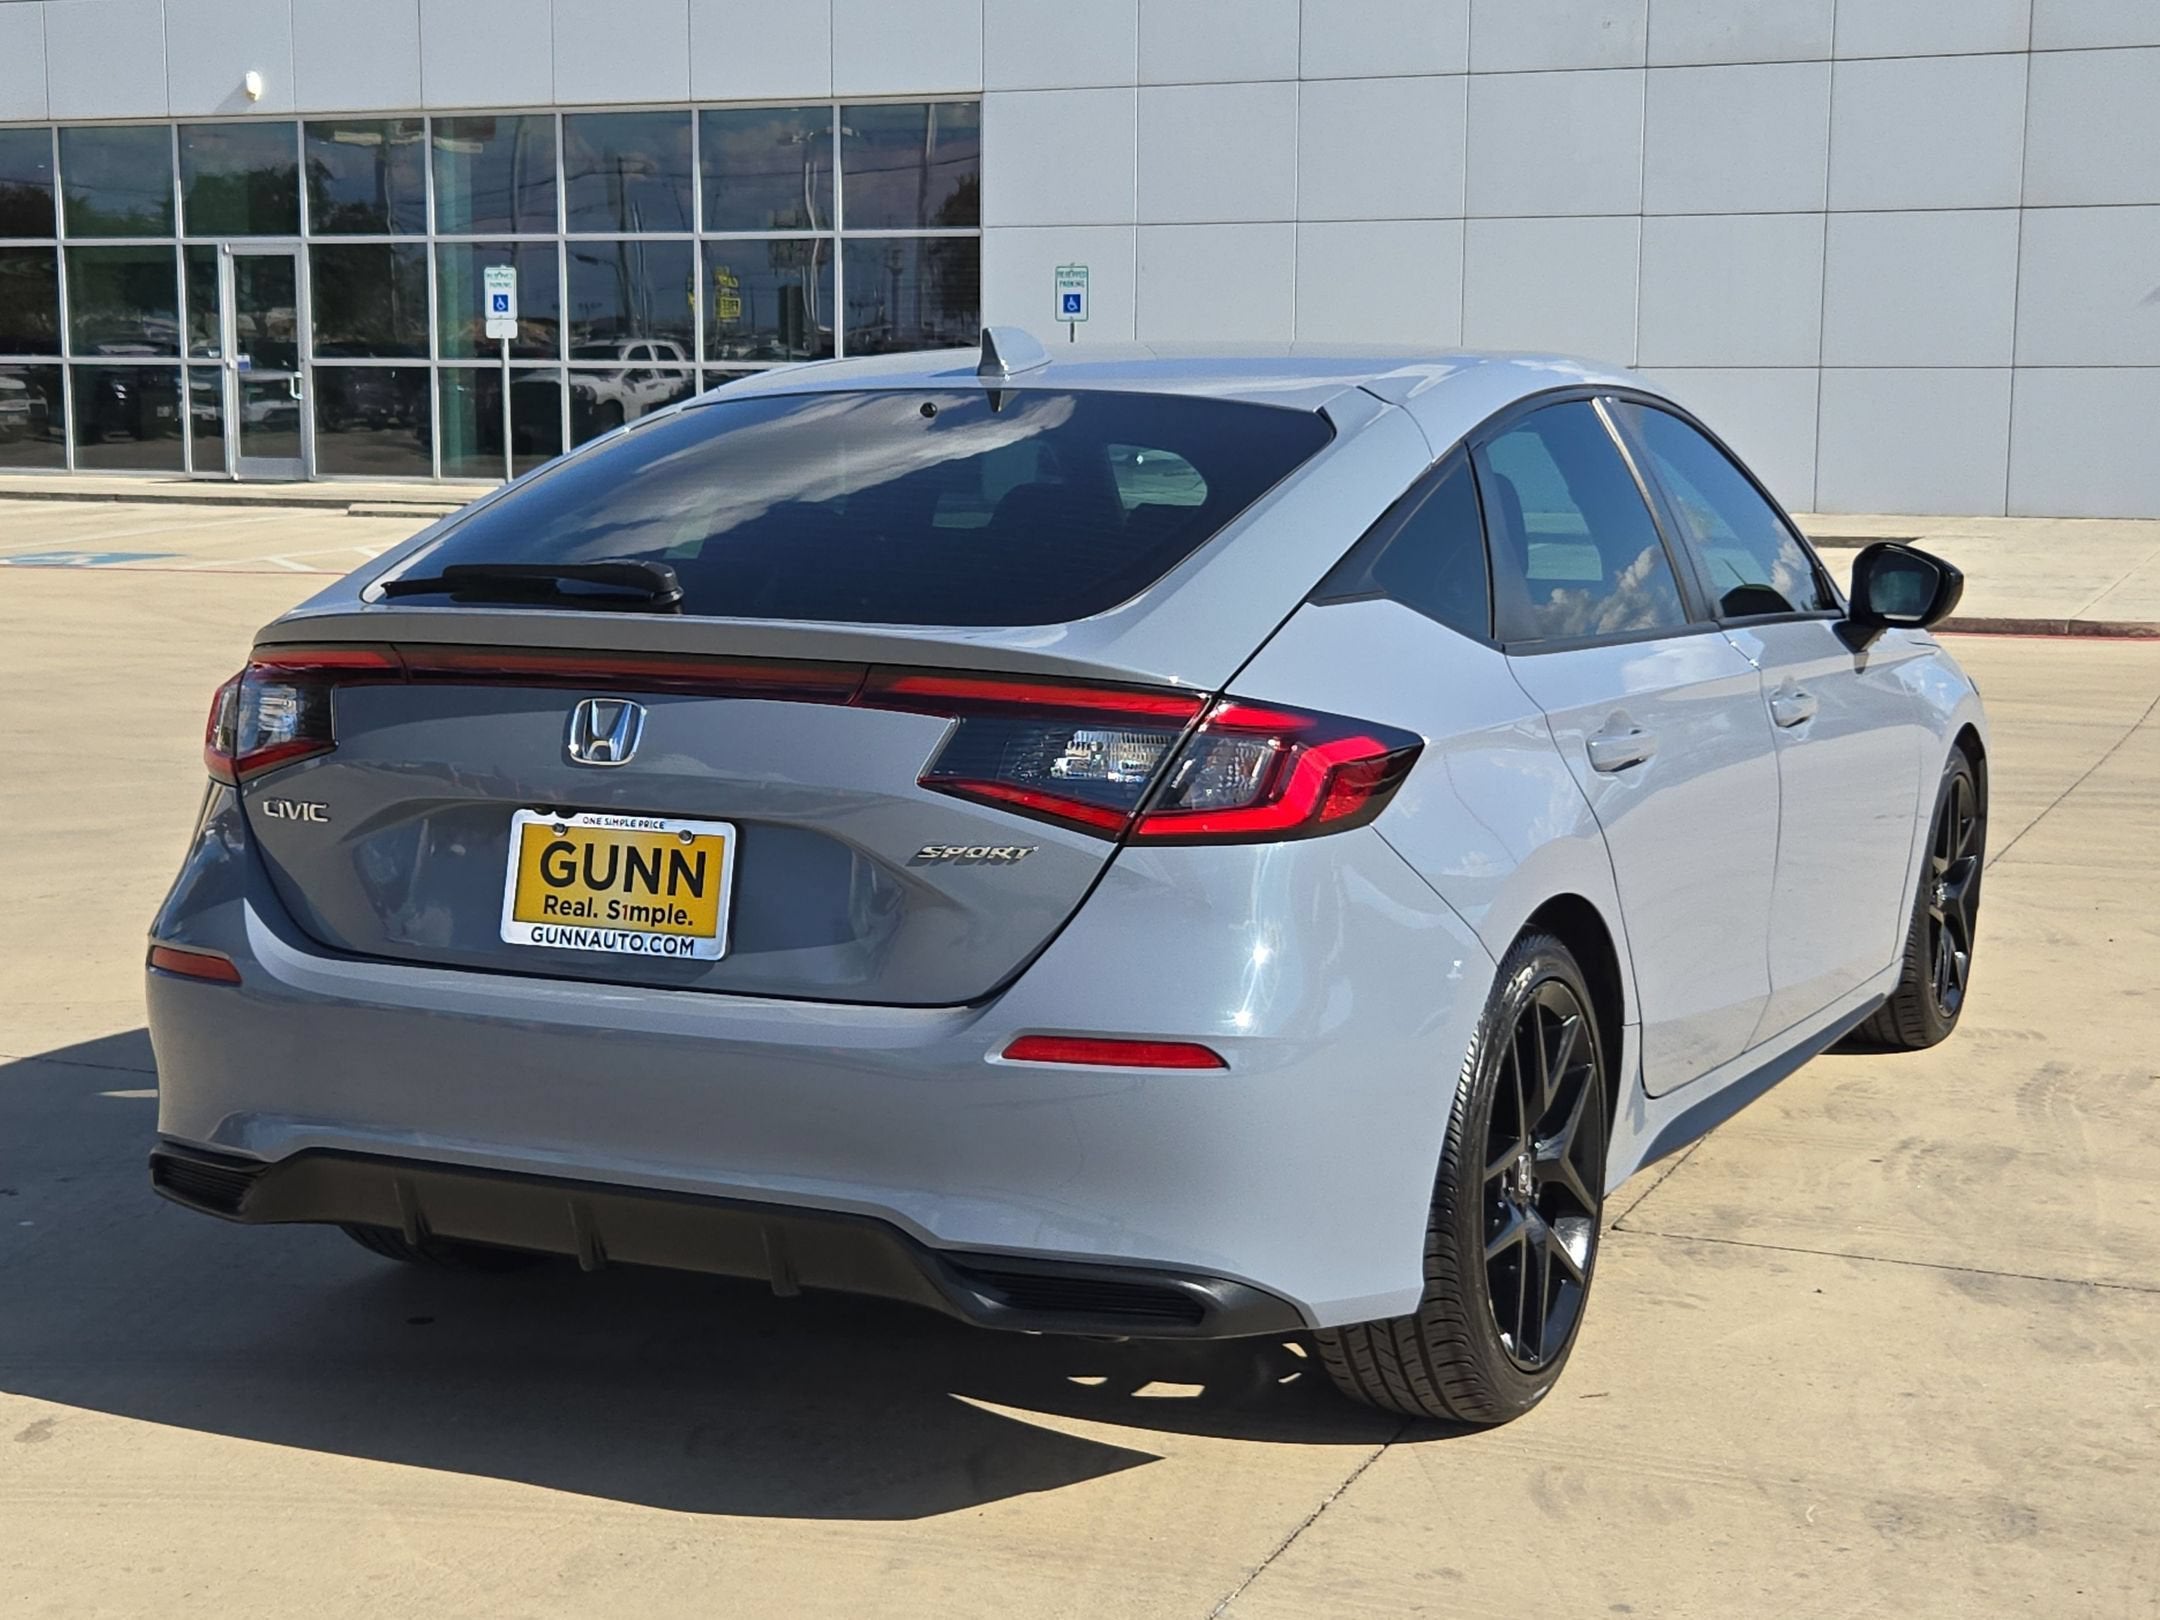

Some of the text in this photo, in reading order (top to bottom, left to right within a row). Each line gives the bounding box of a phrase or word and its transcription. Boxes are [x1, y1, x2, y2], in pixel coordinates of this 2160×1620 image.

[263, 800, 329, 823] CIVIC
[582, 816, 665, 829] ONE SIMPLE PRICE
[917, 846, 1033, 859] SPORT
[540, 841, 706, 898] GUNN
[543, 895, 599, 918] Real.
[531, 926, 695, 956] GUNNAUTO.COM
